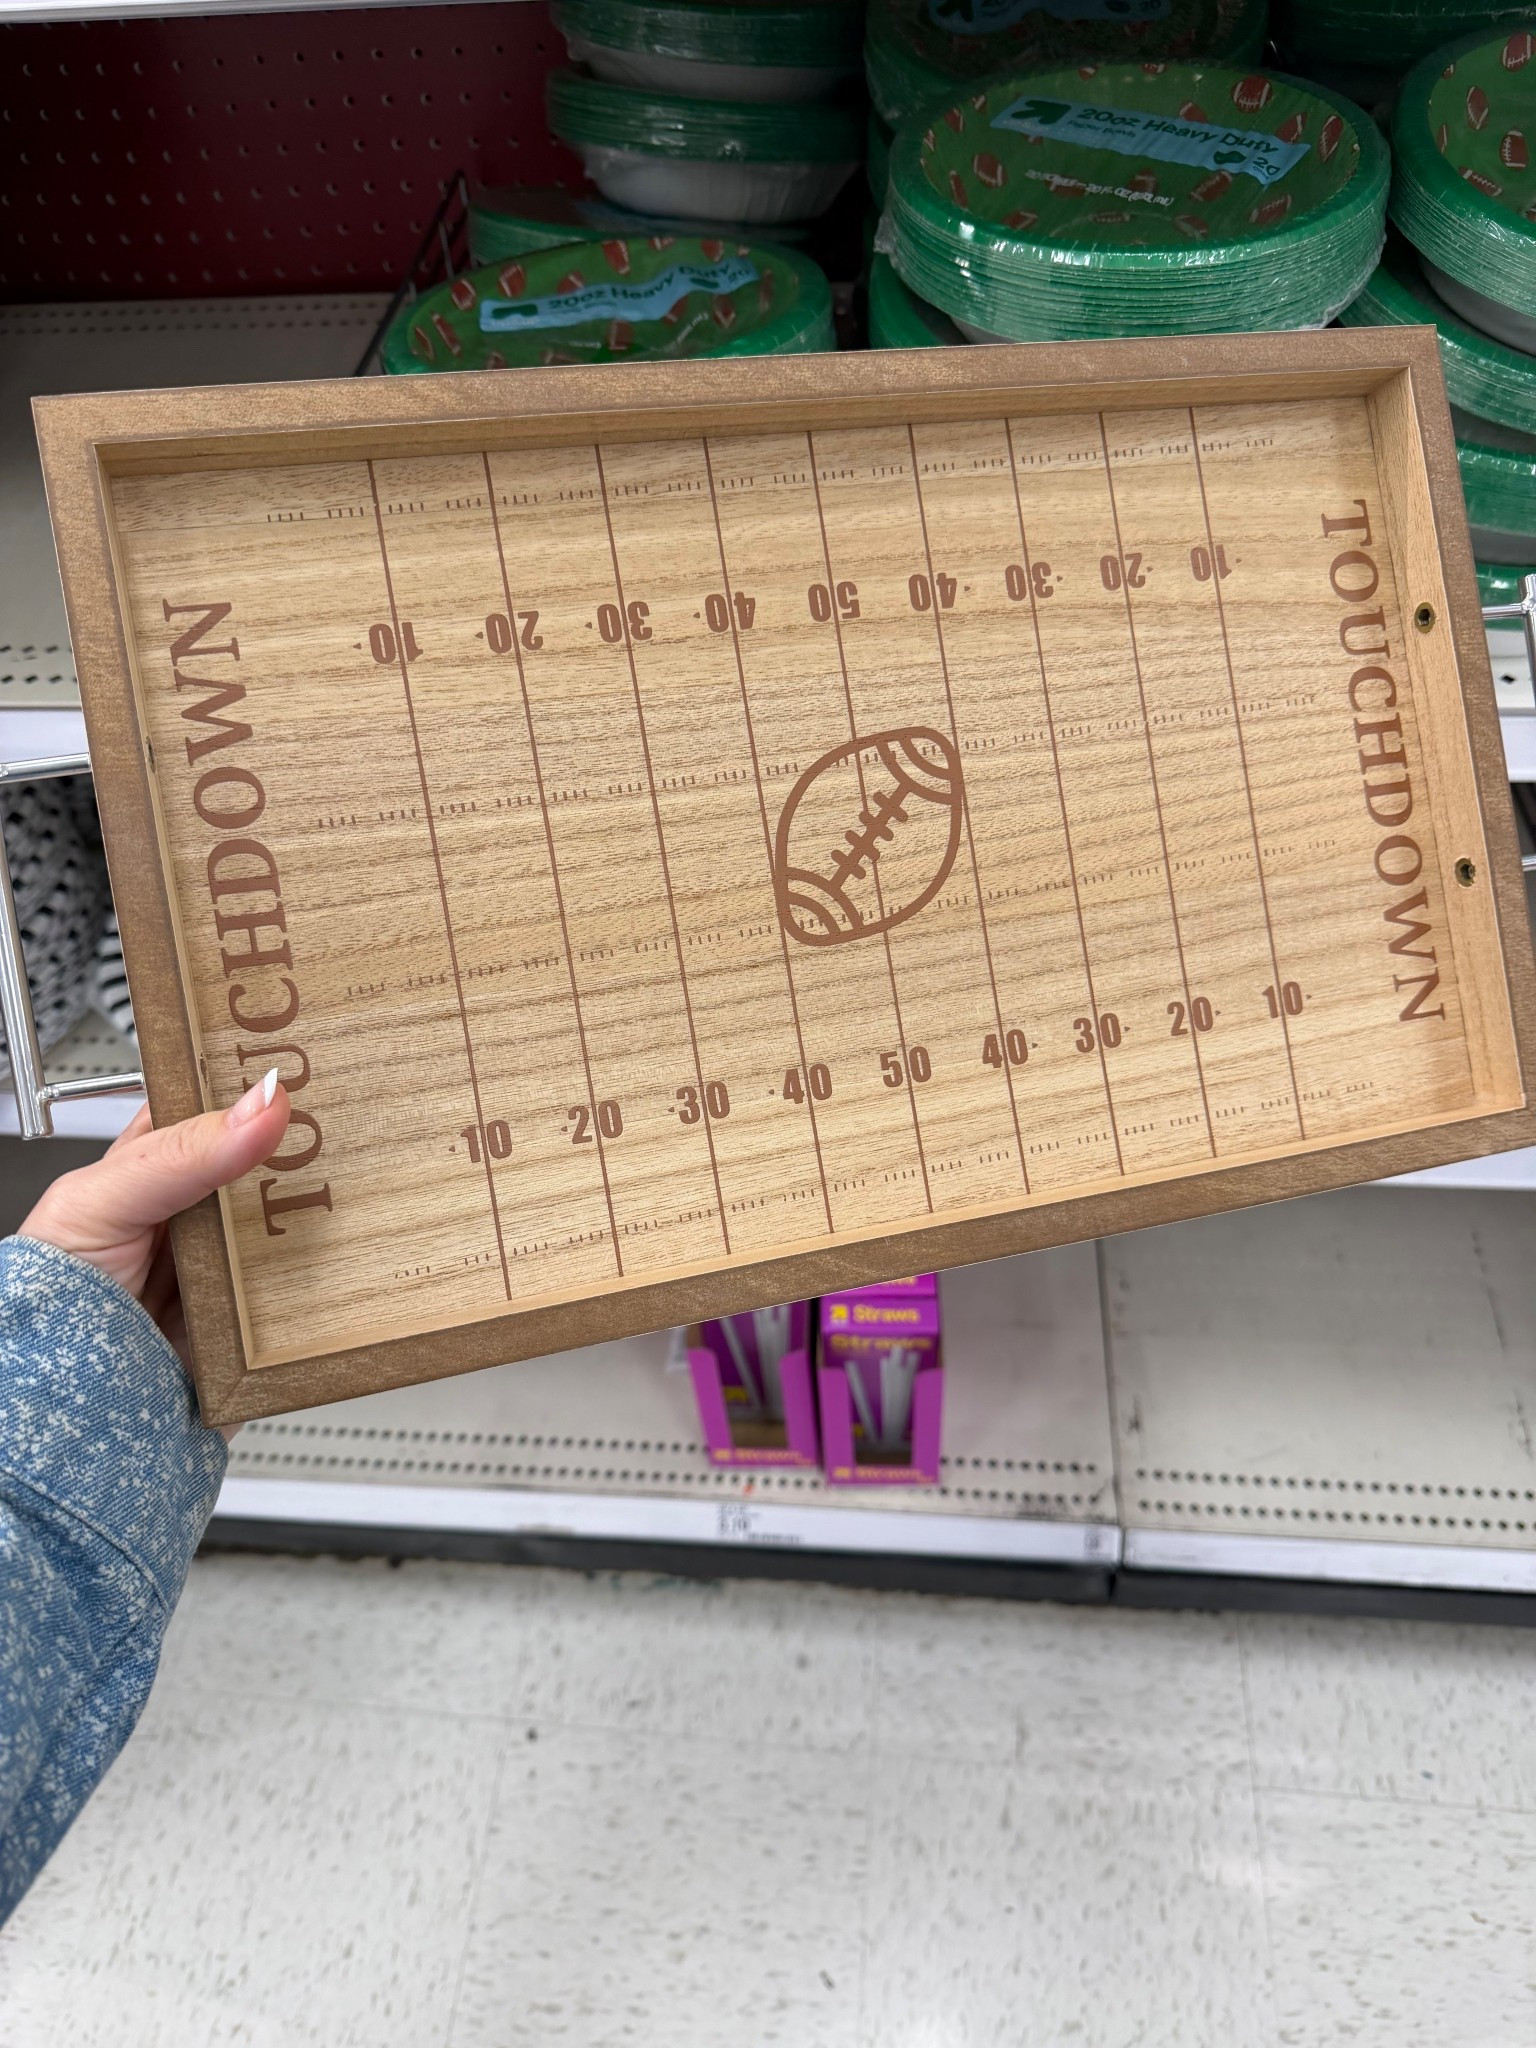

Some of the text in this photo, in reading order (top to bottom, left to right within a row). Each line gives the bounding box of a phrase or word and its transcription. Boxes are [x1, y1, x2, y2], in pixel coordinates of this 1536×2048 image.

[1076, 108, 1141, 127] 20oz
[1142, 118, 1218, 143] Heavy
[1219, 132, 1281, 153] Duty
[1253, 157, 1281, 176] 20
[548, 289, 605, 310] 20oz
[610, 273, 674, 301] Heavy
[678, 264, 732, 280] Duty
[369, 544, 1232, 664] 10 20 30 40 50 40 30 20 10
[1321, 498, 1447, 1024] TOUCHDOWN
[461, 981, 1303, 1163] 10 20 30 40 50 40 30 20 10
[853, 1304, 921, 1323] Straws
